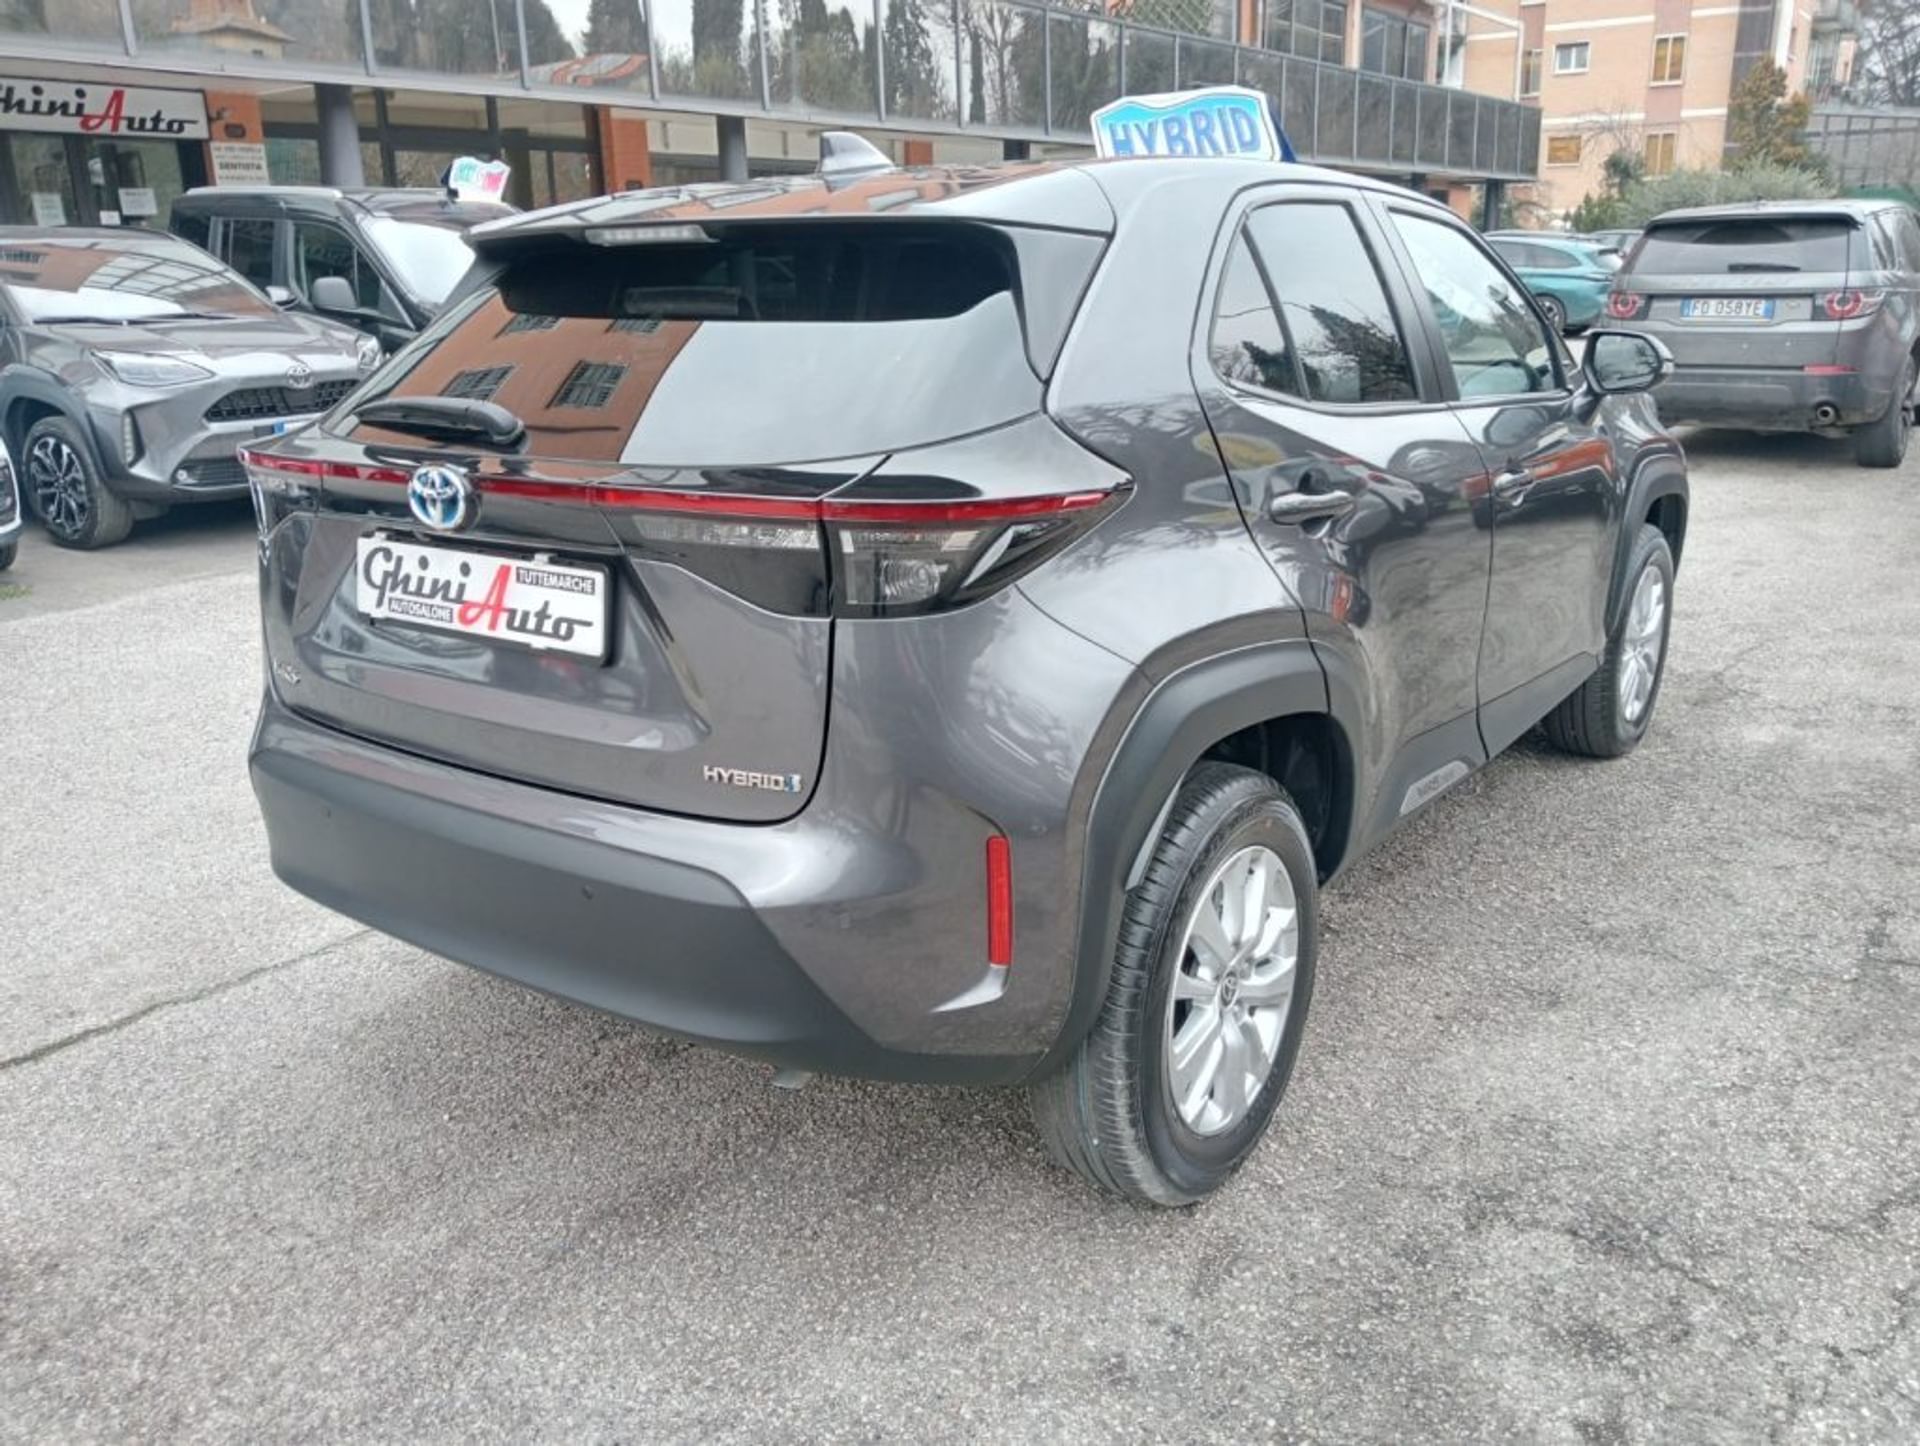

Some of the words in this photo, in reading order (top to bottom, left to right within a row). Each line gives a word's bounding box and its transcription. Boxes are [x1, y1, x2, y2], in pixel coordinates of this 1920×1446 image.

[0, 84, 86, 117] hini
[1108, 106, 1262, 156] HYBRID
[363, 546, 472, 608] Ghini
[457, 564, 594, 642] Auto
[517, 567, 594, 595] TUTTEMARCHE
[389, 598, 453, 623] AUTOSALONE
[703, 764, 785, 791] HYBRID
